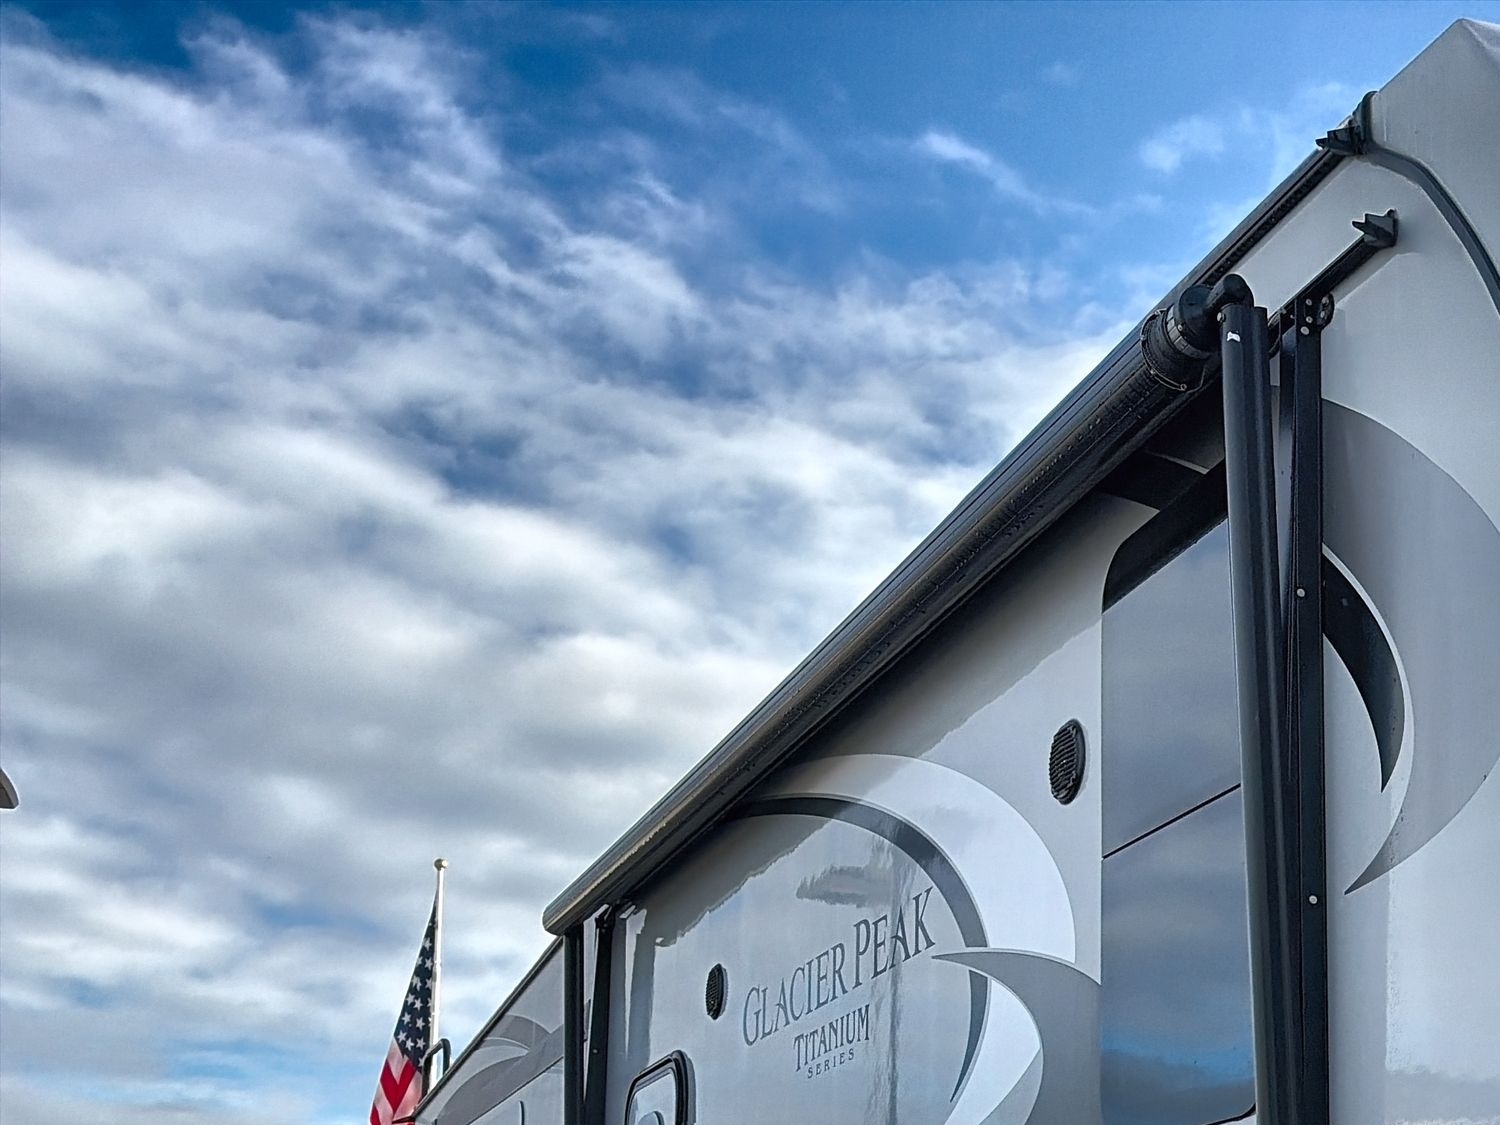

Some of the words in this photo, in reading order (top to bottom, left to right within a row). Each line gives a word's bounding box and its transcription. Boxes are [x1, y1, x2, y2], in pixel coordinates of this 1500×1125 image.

[742, 942, 848, 1047] GLACIER
[852, 886, 936, 990] PEAK
[793, 1003, 870, 1073] TITANIUM
[807, 1048, 855, 1079] SERIES
